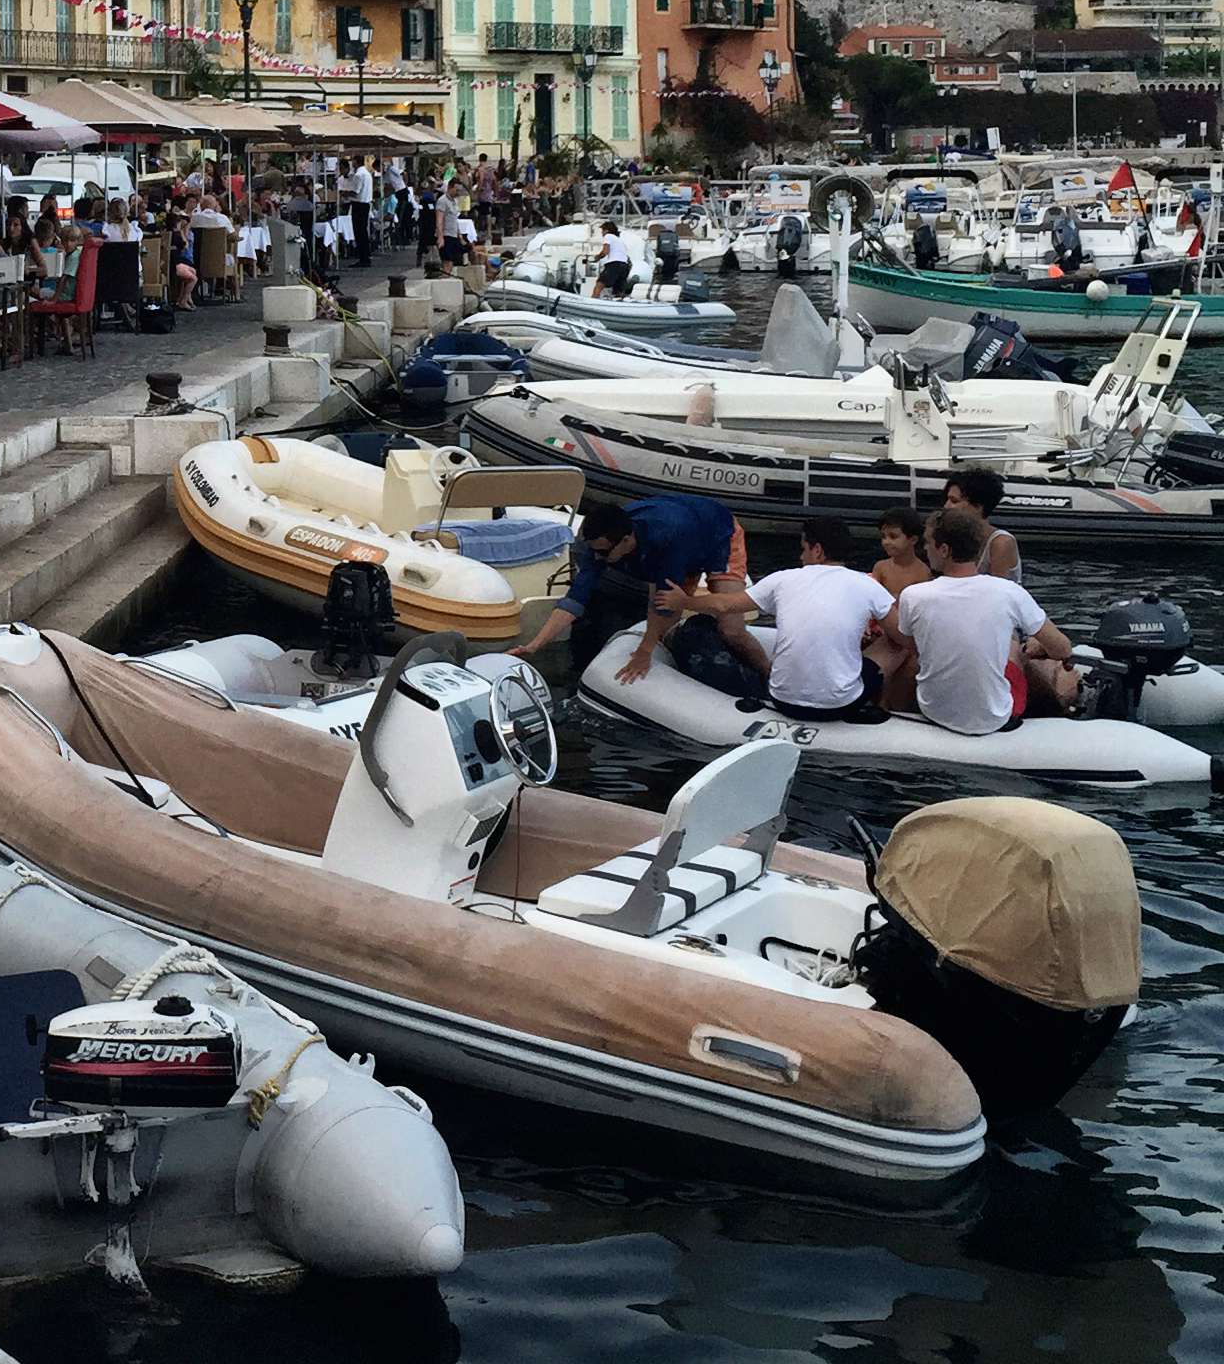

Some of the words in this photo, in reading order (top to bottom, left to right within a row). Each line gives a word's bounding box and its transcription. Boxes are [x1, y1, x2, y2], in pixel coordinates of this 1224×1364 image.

[973, 338, 1004, 374] YAMAHA
[662, 462, 682, 477] NI
[689, 465, 760, 487] E10030
[289, 528, 346, 553] ESPADON
[350, 544, 376, 562] 405
[1129, 622, 1166, 633] YAMAHA
[72, 1039, 209, 1063] MERCURY
